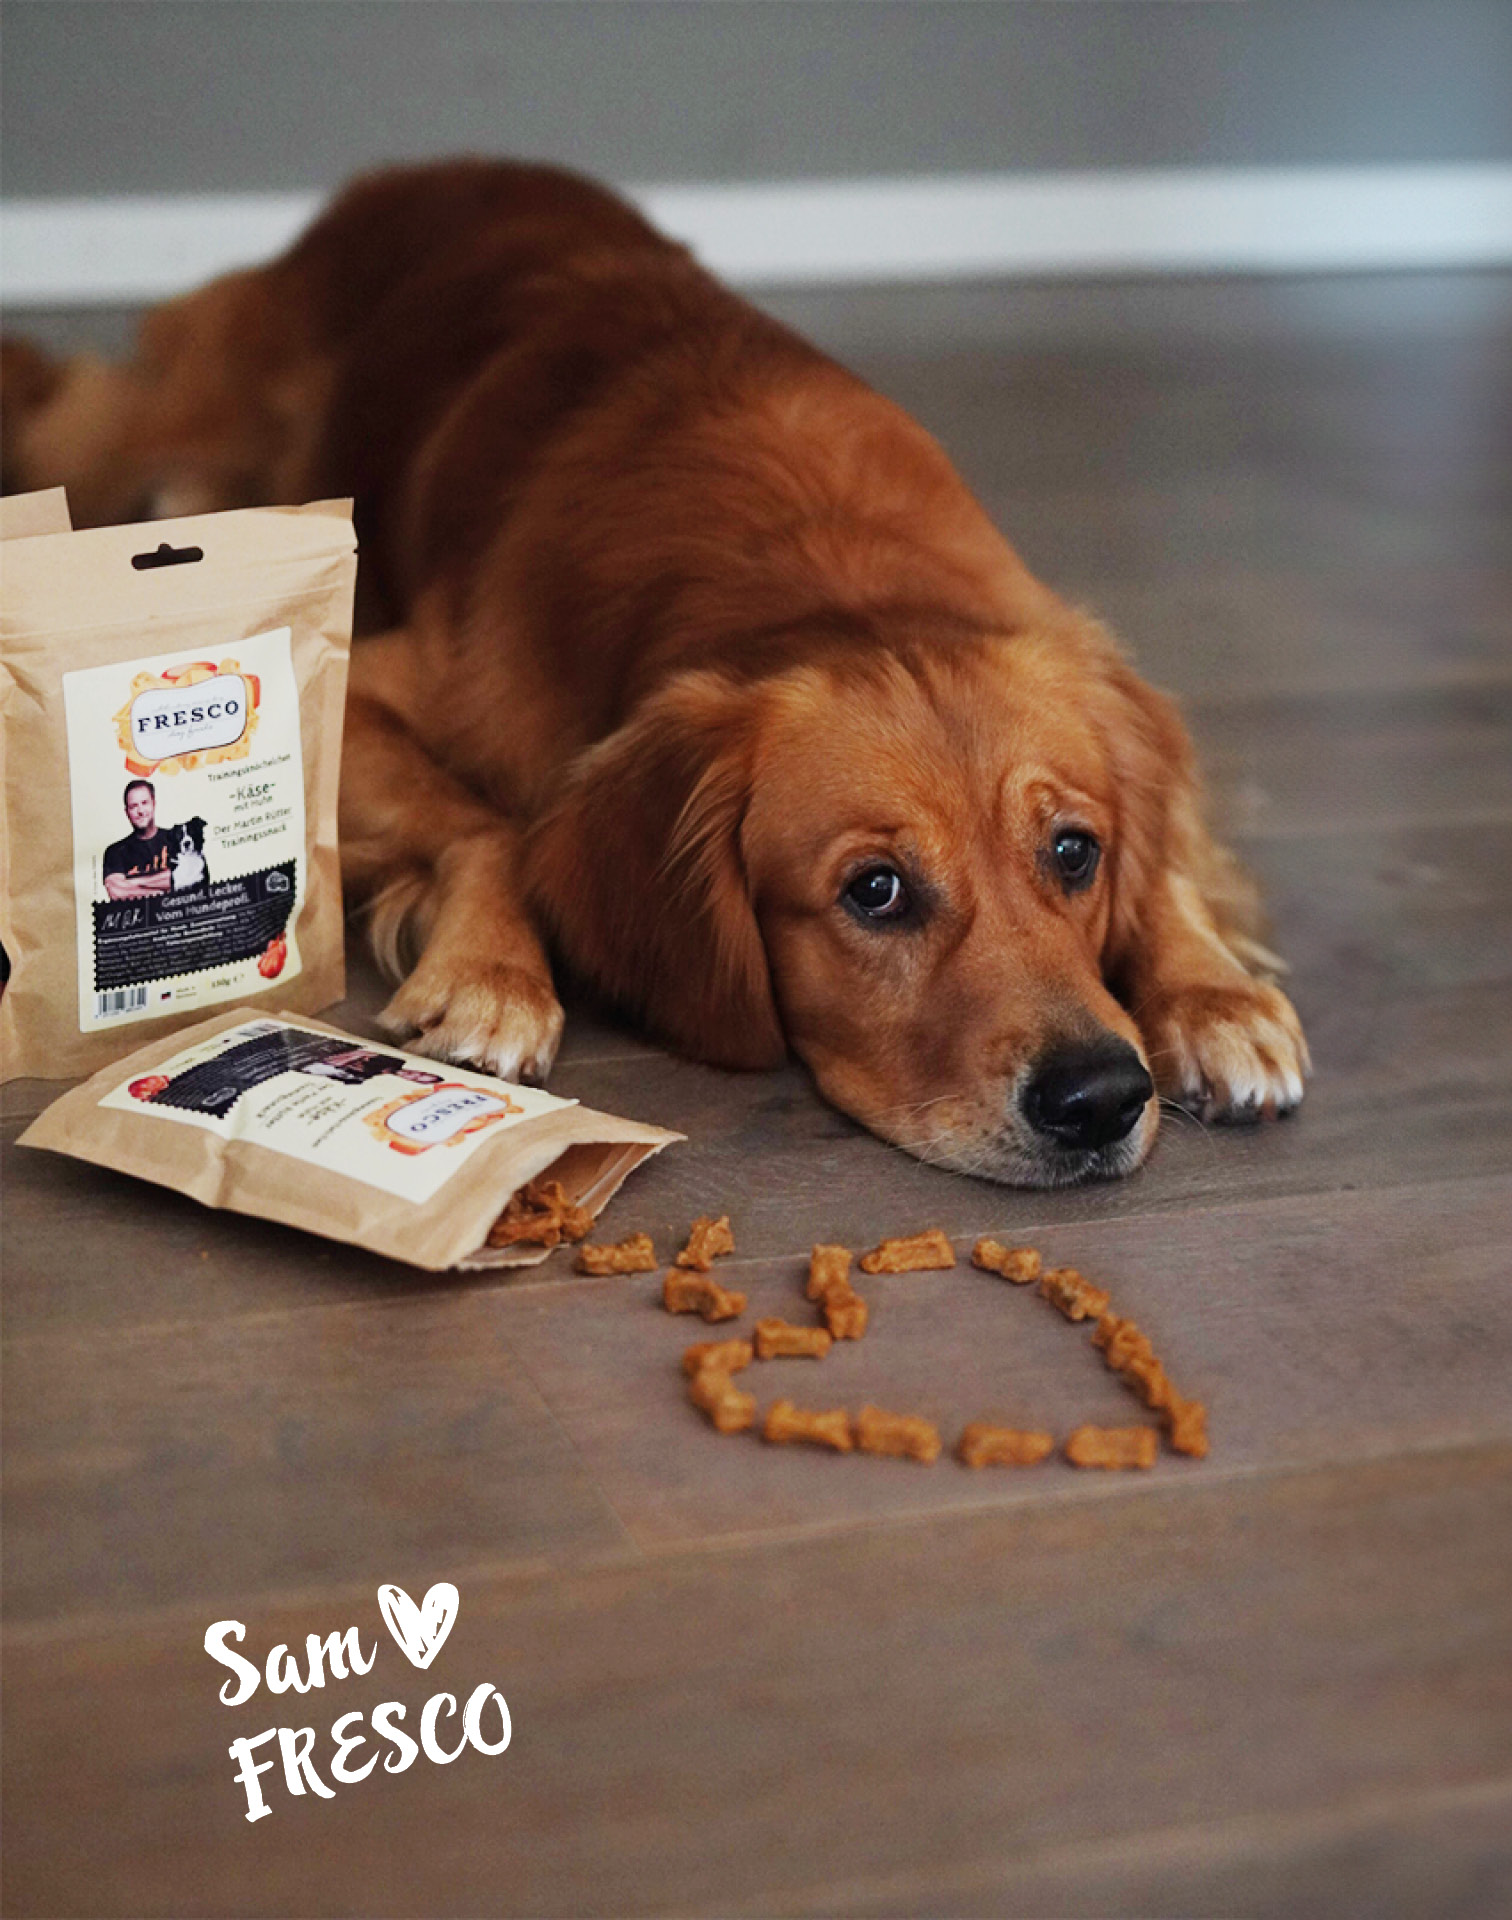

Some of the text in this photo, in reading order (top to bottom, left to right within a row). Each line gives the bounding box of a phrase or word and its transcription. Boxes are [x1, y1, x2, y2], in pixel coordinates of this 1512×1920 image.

[138, 700, 239, 733] FRESCO
[213, 824, 232, 836] Der
[233, 815, 264, 830] Martin
[155, 909, 184, 922] Vom
[410, 1094, 488, 1132] FRESCO
